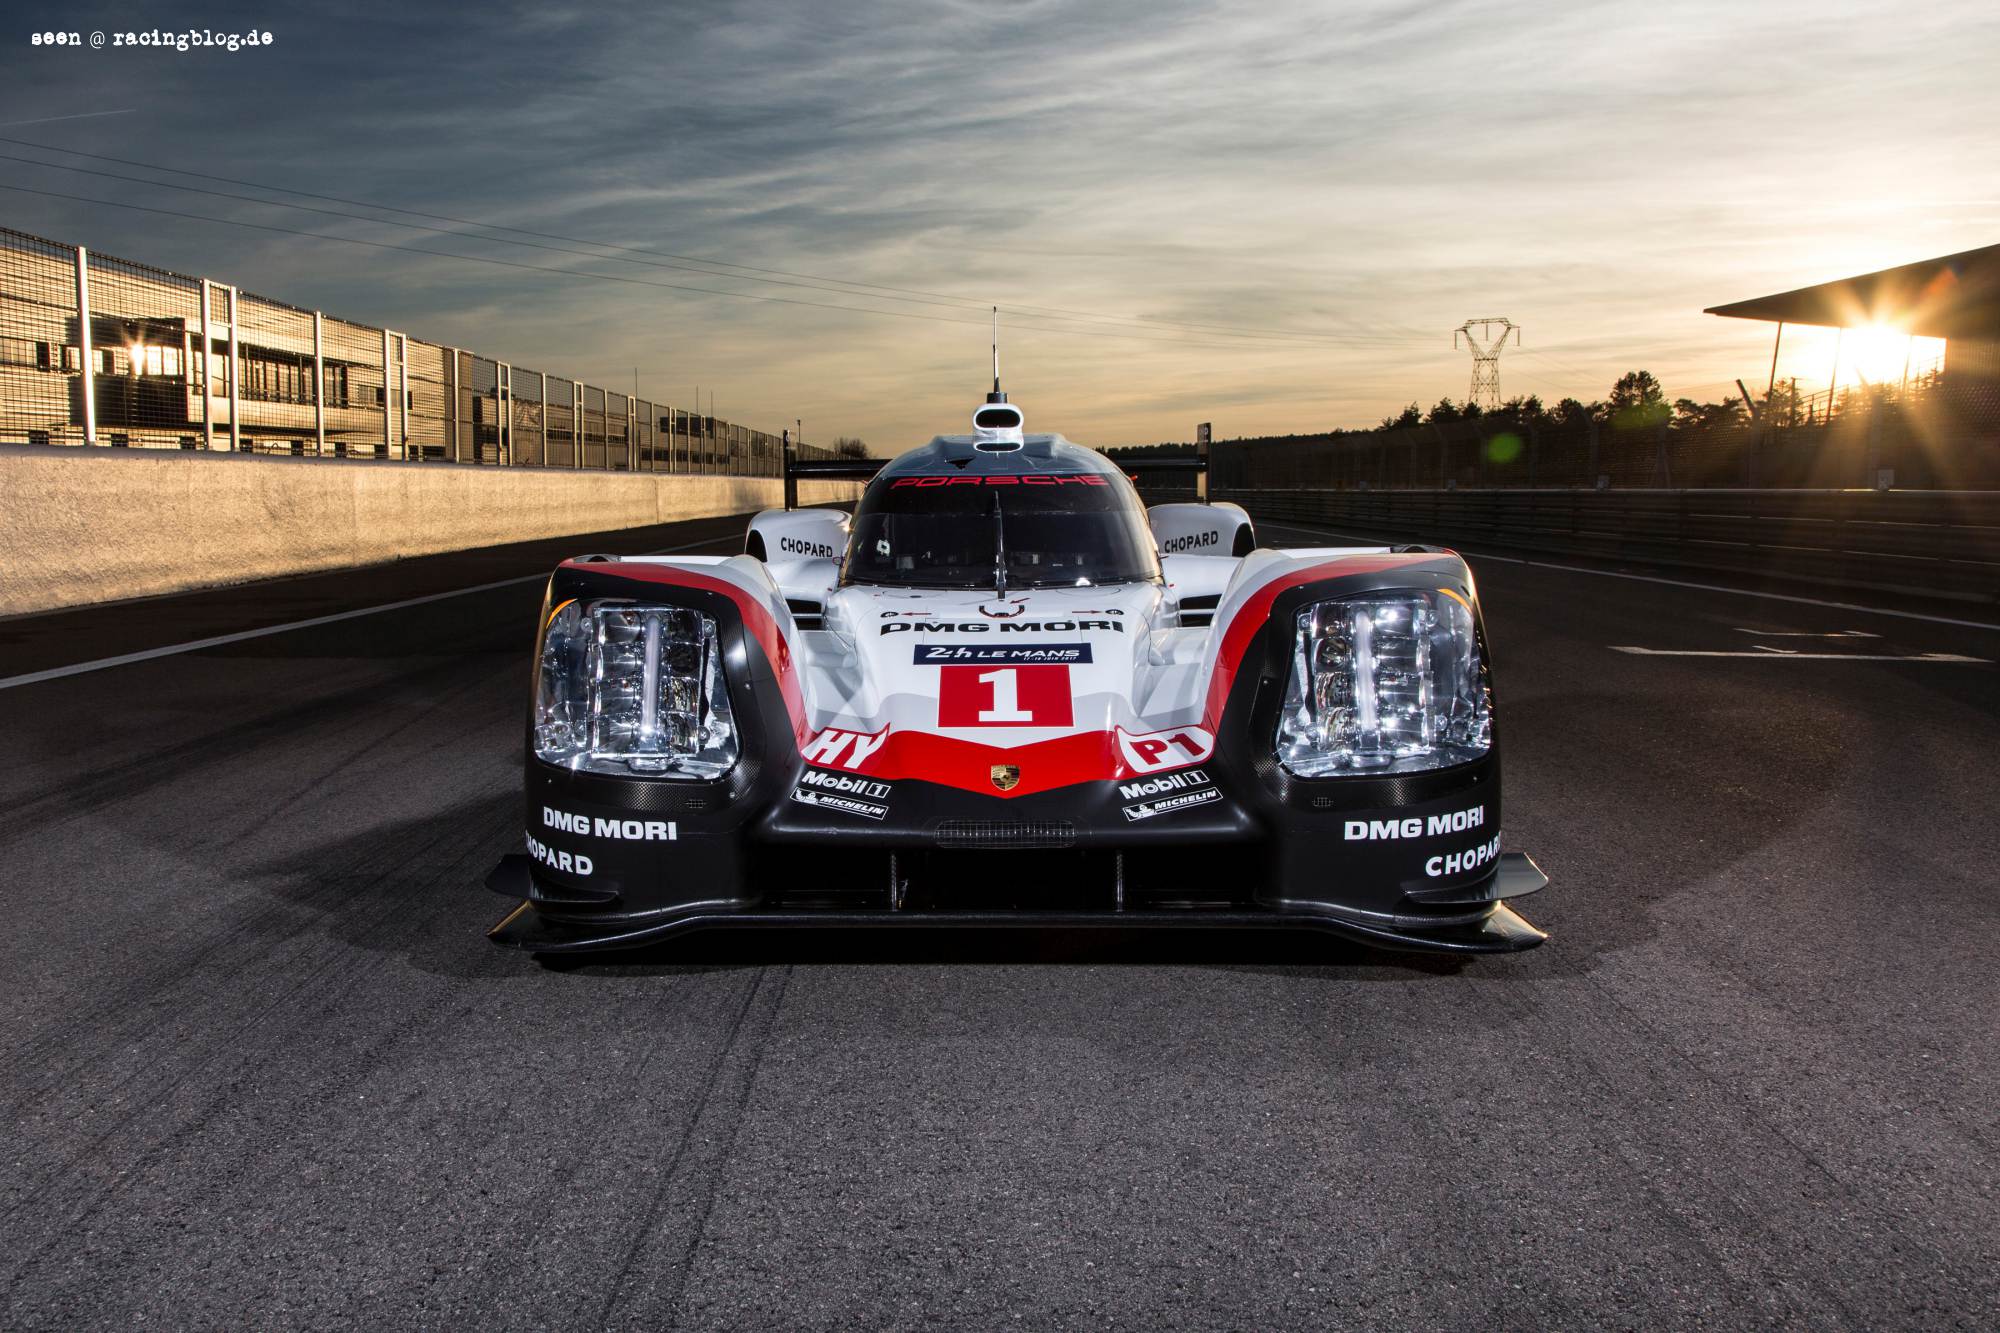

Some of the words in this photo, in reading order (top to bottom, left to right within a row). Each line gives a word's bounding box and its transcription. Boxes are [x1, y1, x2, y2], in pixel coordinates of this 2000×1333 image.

[891, 475, 1109, 490] PORSCHE
[780, 537, 833, 558] CHOPARD
[1164, 530, 1219, 553] CHOPARD
[880, 622, 990, 636] DMG
[1000, 620, 1124, 634] MORI
[977, 650, 1008, 658] LE
[1011, 649, 1080, 658] MANS
[978, 668, 1033, 722] 1
[801, 729, 888, 769] HY
[1129, 732, 1206, 766] P1
[801, 770, 869, 795] Mobil
[1118, 774, 1187, 800] Mobil
[819, 796, 885, 815] MICHELIN
[1154, 790, 1217, 810] MICHELIN
[543, 806, 590, 835] DMG
[594, 817, 678, 841] MORI
[1344, 818, 1423, 841] DMG
[1427, 805, 1485, 836] MORI
